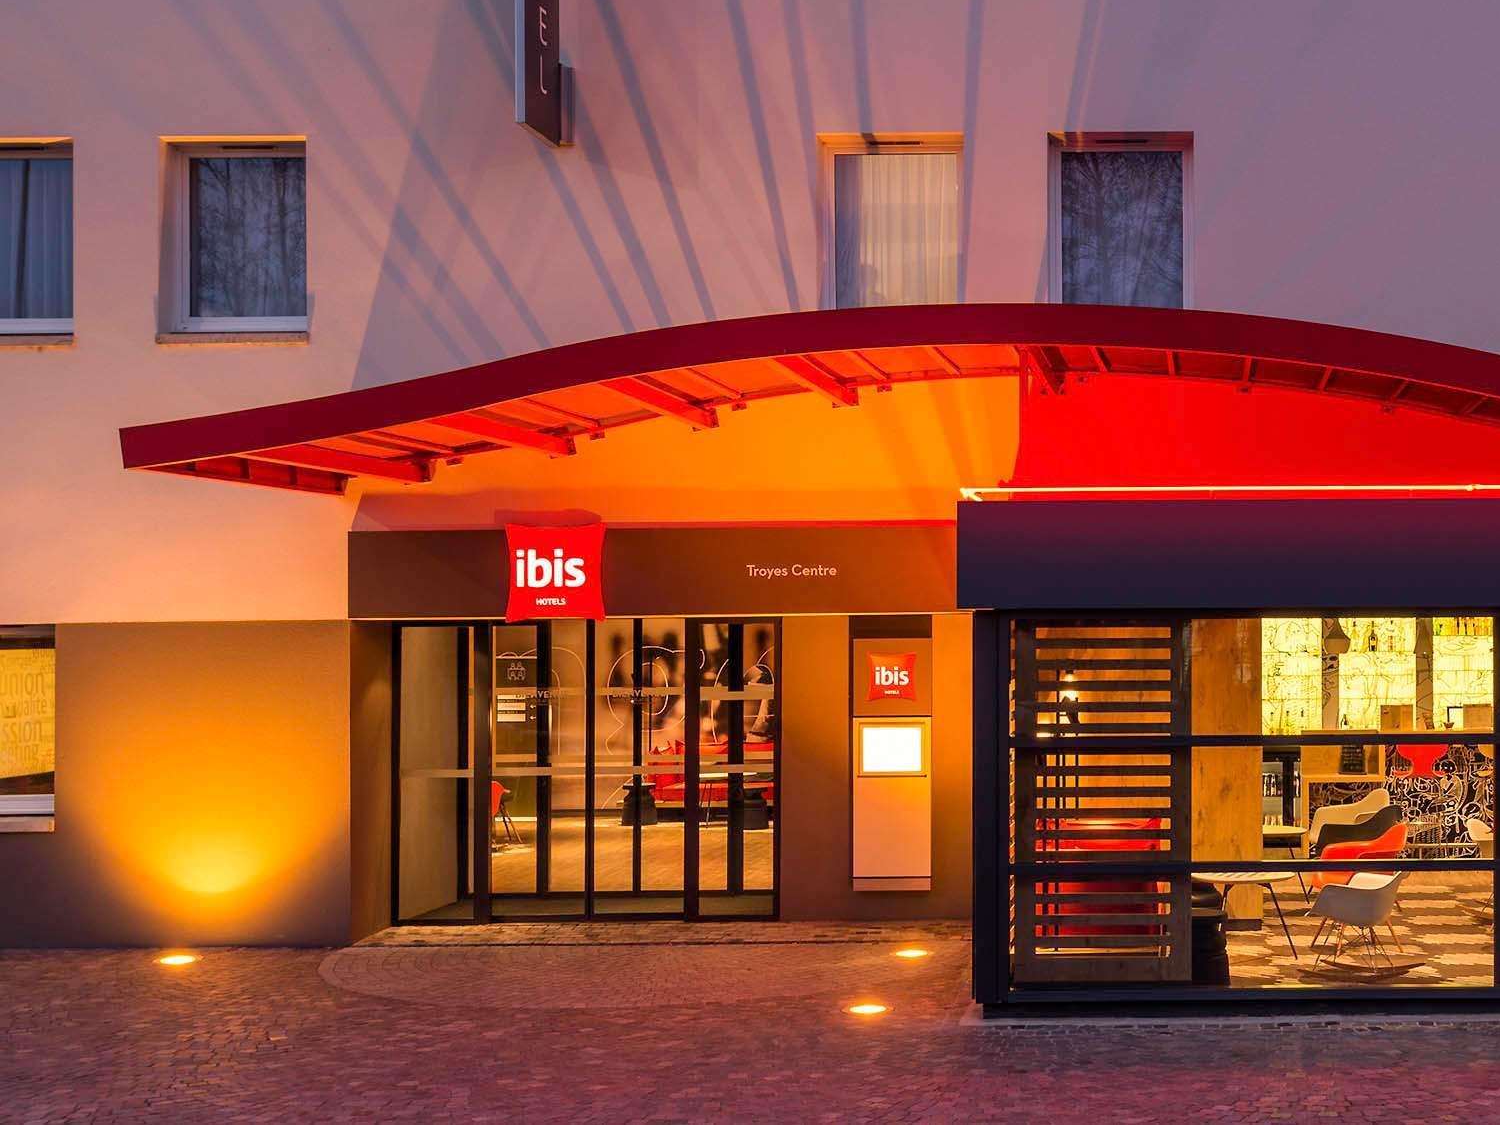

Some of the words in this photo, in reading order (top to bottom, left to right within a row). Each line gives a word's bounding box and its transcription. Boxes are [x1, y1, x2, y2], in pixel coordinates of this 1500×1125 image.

[516, 548, 586, 588] ibis
[746, 564, 788, 579] Troyes
[791, 563, 837, 576] Centre
[535, 597, 567, 606] HOTELS
[875, 666, 909, 686] ibis
